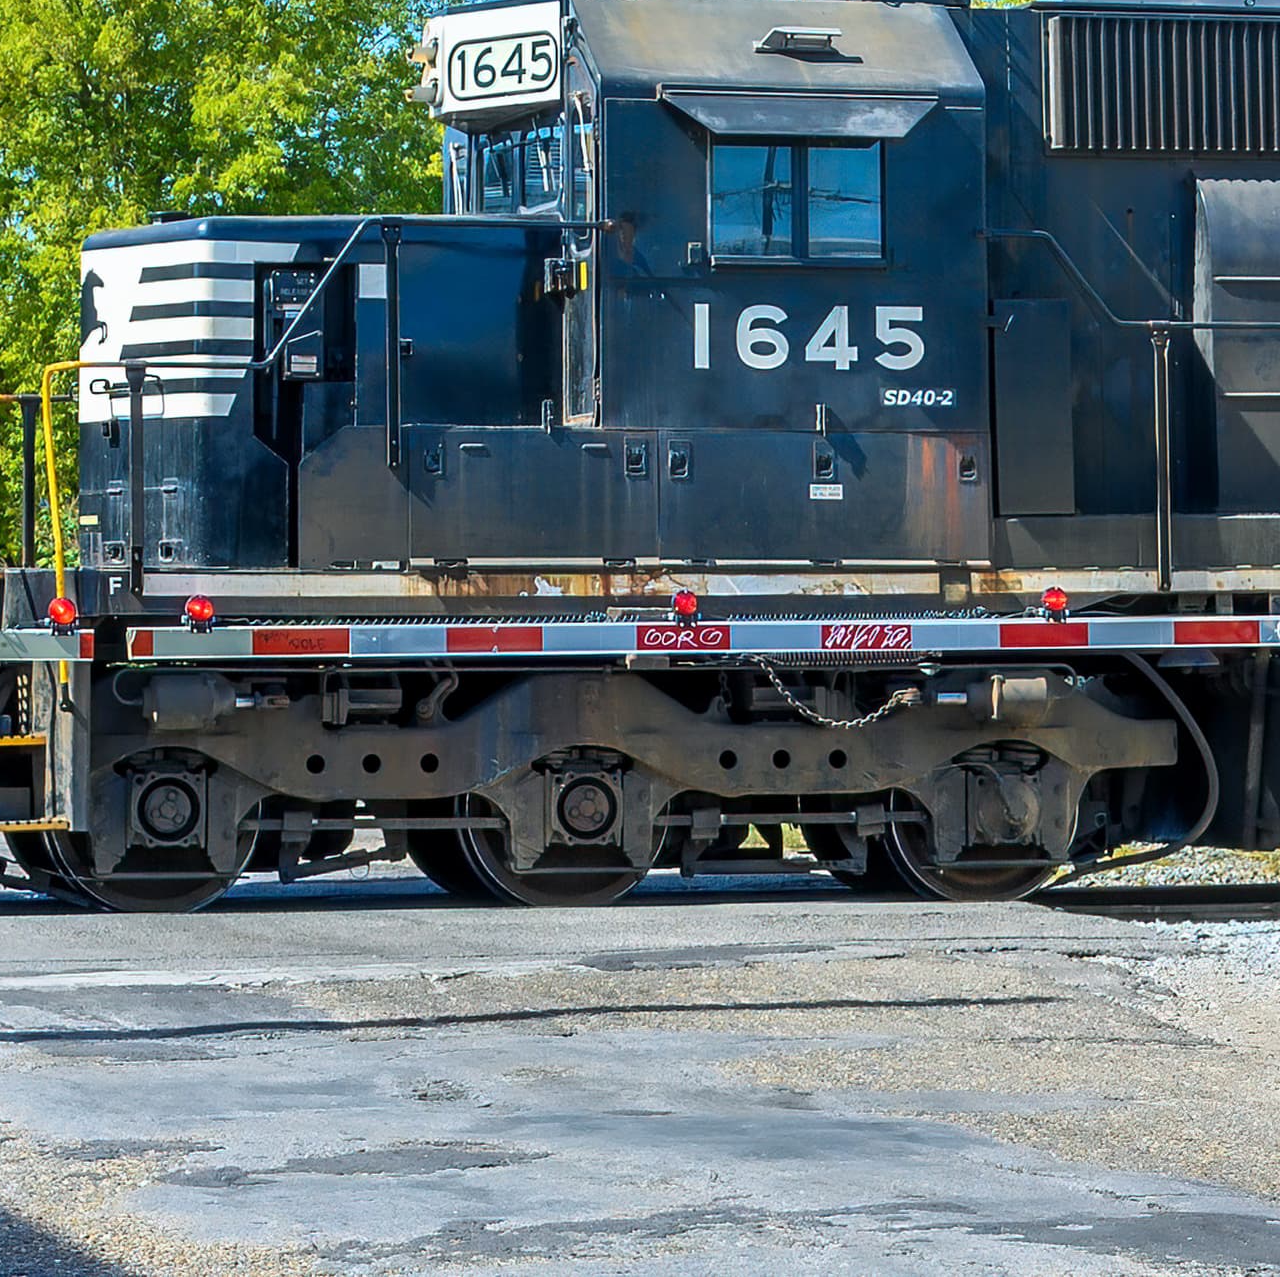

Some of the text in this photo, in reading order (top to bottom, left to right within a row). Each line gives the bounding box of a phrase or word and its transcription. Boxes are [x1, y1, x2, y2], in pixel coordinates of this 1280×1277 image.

[456, 39, 553, 92] 1645
[693, 303, 925, 370] 1645
[883, 389, 953, 407] SD40-2
[108, 576, 122, 595] F
